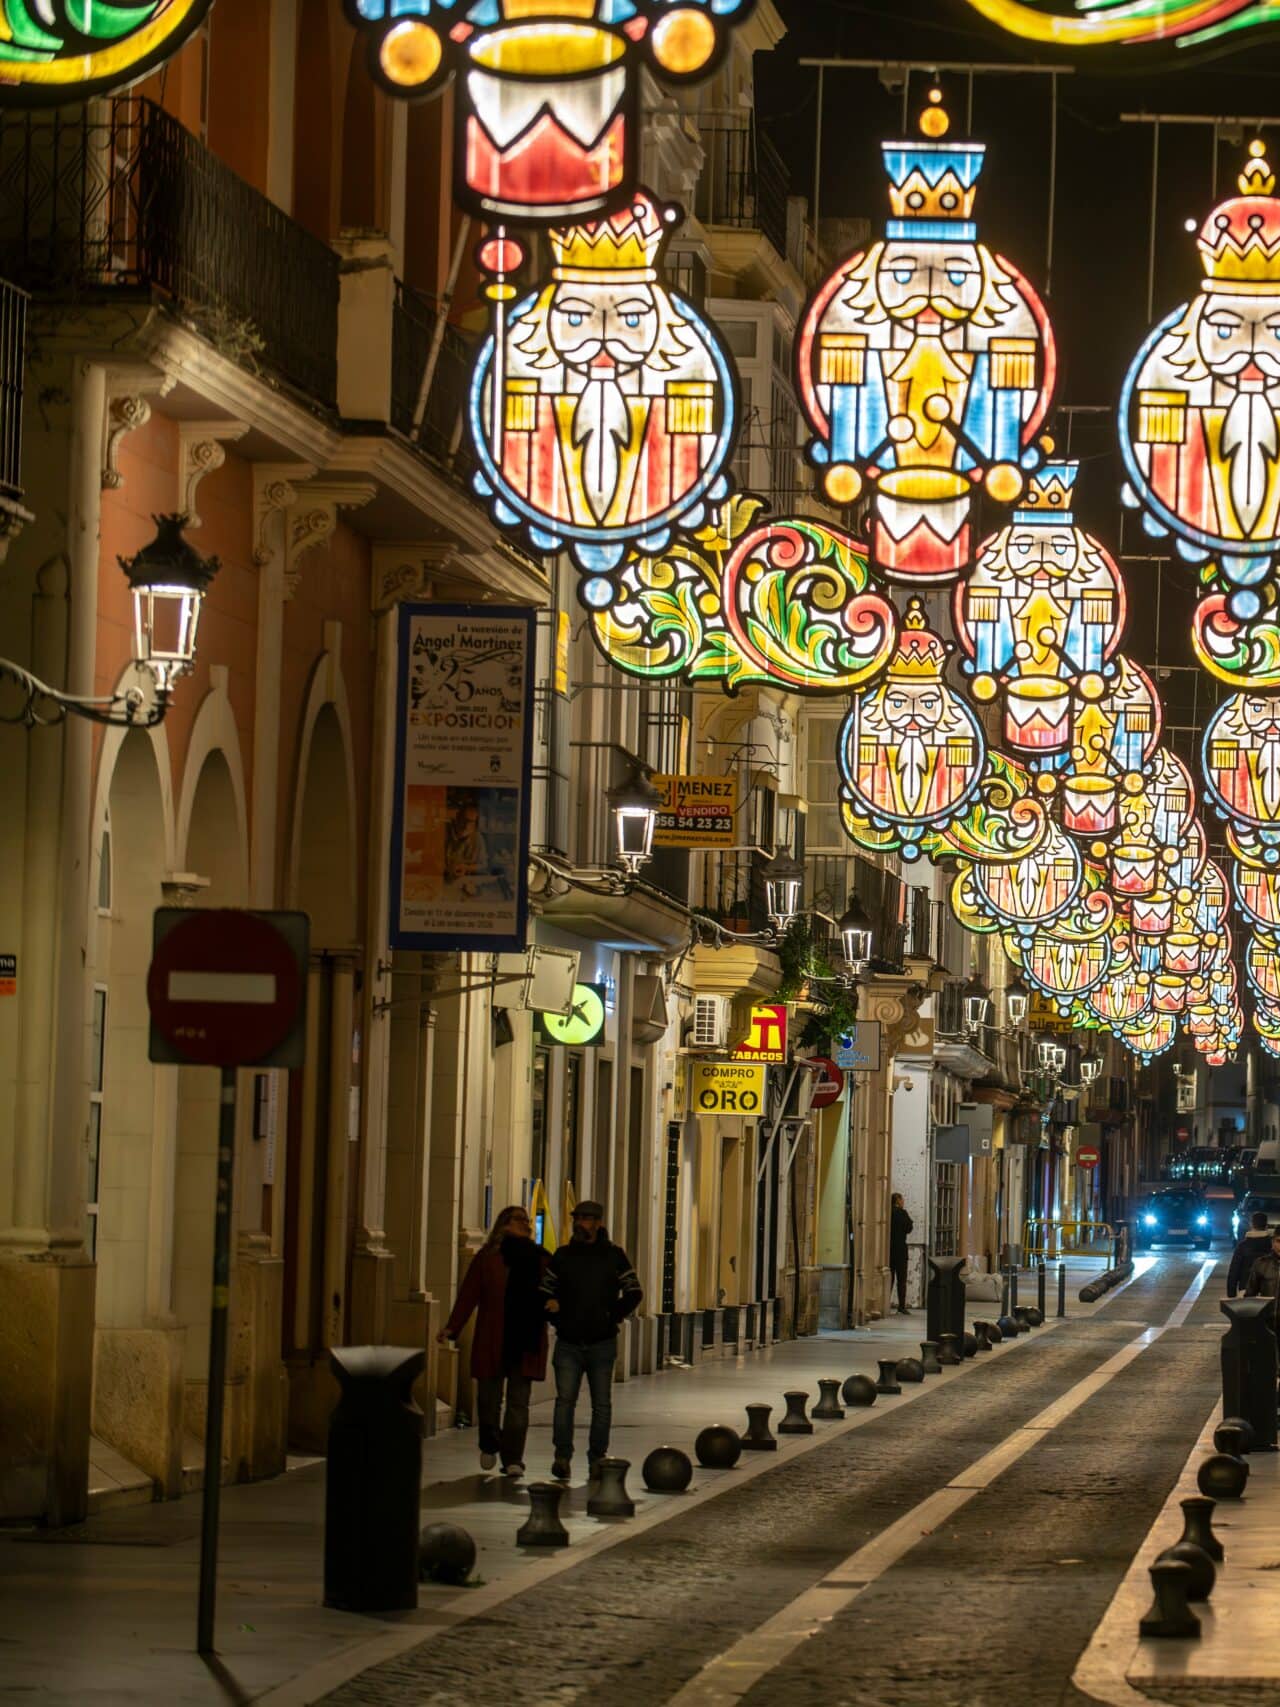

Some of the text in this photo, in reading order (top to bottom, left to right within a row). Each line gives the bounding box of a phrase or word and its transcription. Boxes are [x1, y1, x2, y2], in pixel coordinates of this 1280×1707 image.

[679, 806, 728, 817] VENDIDO
[678, 817, 693, 828] 54
[697, 818, 713, 829] 23
[715, 819, 731, 830] 23
[702, 1067, 755, 1079] COMPRO
[699, 1089, 759, 1111] ORO
